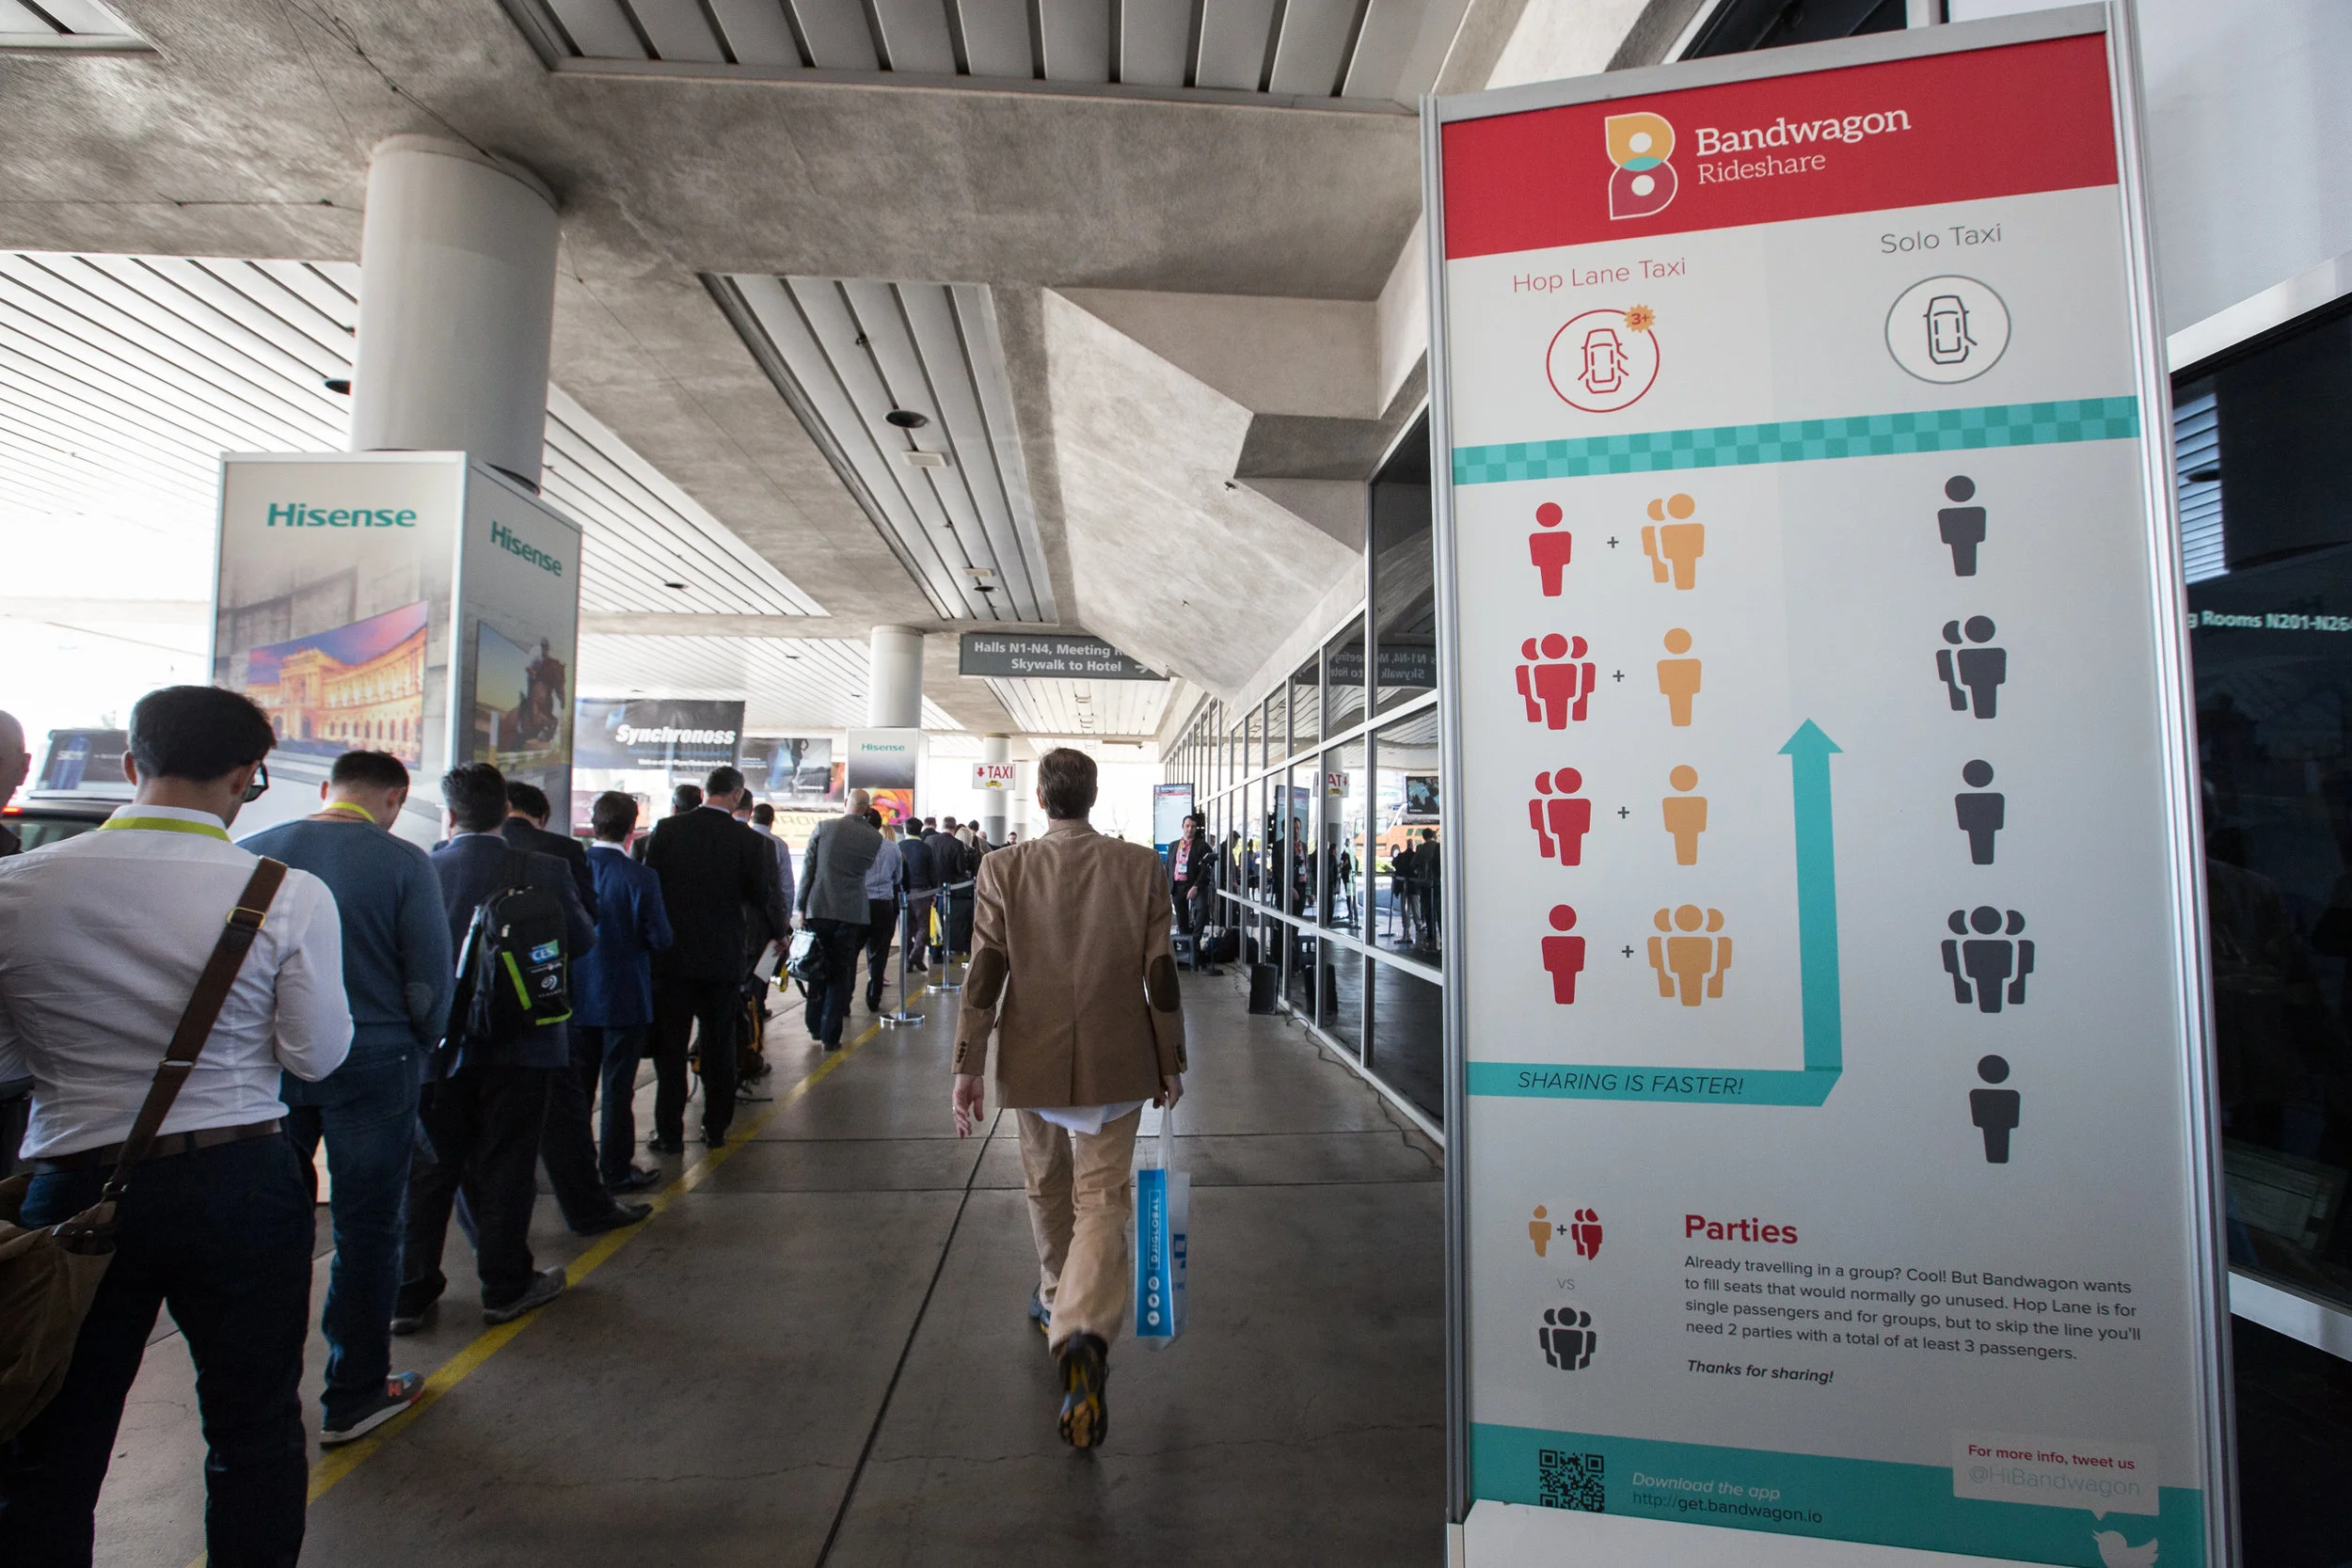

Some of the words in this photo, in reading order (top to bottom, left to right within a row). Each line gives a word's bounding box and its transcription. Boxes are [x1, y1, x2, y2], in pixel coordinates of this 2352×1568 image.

[1695, 109, 1912, 157] Bandwagon
[1697, 154, 1826, 185] Rideshare
[1881, 230, 1940, 254] Solo
[1948, 223, 2001, 246] Taxi
[1513, 273, 1563, 293] Hop
[1572, 265, 1630, 287] Lane
[1638, 257, 1686, 279] Taxi
[267, 503, 417, 527] Hisense
[490, 520, 562, 577] Hisense
[2201, 610, 2263, 627] Rooms
[974, 641, 1006, 654] Halls
[1009, 642, 1052, 656] N1-N4,
[1057, 644, 1110, 658] Meeting
[1011, 658, 1065, 672] Skywalk
[1069, 660, 1083, 671] to
[1088, 660, 1121, 672] Hotel
[615, 724, 736, 745] Synchronoss
[862, 743, 905, 752] Hisense
[988, 766, 1013, 779] TAXI
[1518, 1071, 1617, 1091] SHARING
[1625, 1074, 1645, 1092] IS
[1652, 1075, 1743, 1095] FASTER!
[1685, 1214, 1798, 1244] Parties
[1684, 1256, 1741, 1274] Already
[1745, 1259, 1813, 1277] travelling
[1818, 1263, 1831, 1276] in
[1836, 1267, 1845, 1276] a
[1849, 1267, 1902, 1282] group?
[1906, 1268, 1947, 1283] Cool!
[1951, 1271, 1979, 1285] But
[1982, 1273, 2078, 1292] Bandwagon
[2083, 1279, 2132, 1294] wants
[1684, 1277, 1699, 1290] to
[1703, 1278, 1720, 1291] fill
[1724, 1281, 1763, 1294] seats
[1767, 1282, 1796, 1296] that
[1800, 1286, 1846, 1299] would
[1850, 1289, 1915, 1307] normally
[1920, 1293, 1941, 1307] go
[1946, 1295, 2009, 1309] unused.
[2012, 1297, 2048, 1313] Hop
[2053, 1299, 2092, 1315] Lane
[2096, 1302, 2110, 1316] is
[2114, 1303, 2137, 1317] for
[1685, 1299, 1729, 1315] single
[1733, 1303, 1820, 1321] passengers
[1824, 1309, 1852, 1322] and
[1857, 1310, 1877, 1323] for
[1883, 1312, 1941, 1329] groups,
[1946, 1316, 1970, 1329] but
[1976, 1318, 1992, 1331] to
[1996, 1320, 2028, 1335] skip
[2033, 1322, 2059, 1335] the
[2064, 1323, 2093, 1337] line
[2098, 1326, 2141, 1341] you'll
[1686, 1323, 1723, 1335] need
[1728, 1323, 1738, 1336] 2
[1742, 1325, 1792, 1339] parties
[1797, 1328, 1827, 1342] with
[1833, 1334, 1841, 1343] a
[1846, 1332, 1880, 1346] total
[1884, 1335, 1899, 1347] of
[1904, 1337, 1918, 1349] at
[1923, 1337, 1960, 1352] least
[1964, 1339, 1975, 1353] 3
[1979, 1342, 2077, 1360] passengers.
[1688, 1360, 1741, 1375] Thanks
[1746, 1365, 1768, 1378] for
[1772, 1367, 1834, 1385] sharing!
[1968, 1444, 1992, 1457] For
[1995, 1449, 2033, 1462] more
[2037, 1450, 2068, 1465] info,
[2073, 1454, 2113, 1468] tweet
[2118, 1459, 2136, 1470] us
[1632, 1472, 1714, 1494] Download
[1718, 1481, 1743, 1497] the
[1748, 1486, 1781, 1502] app
[1968, 1465, 2140, 1497] @HiBandwagon
[1632, 1491, 1822, 1524] http://get.bandwagon.io
